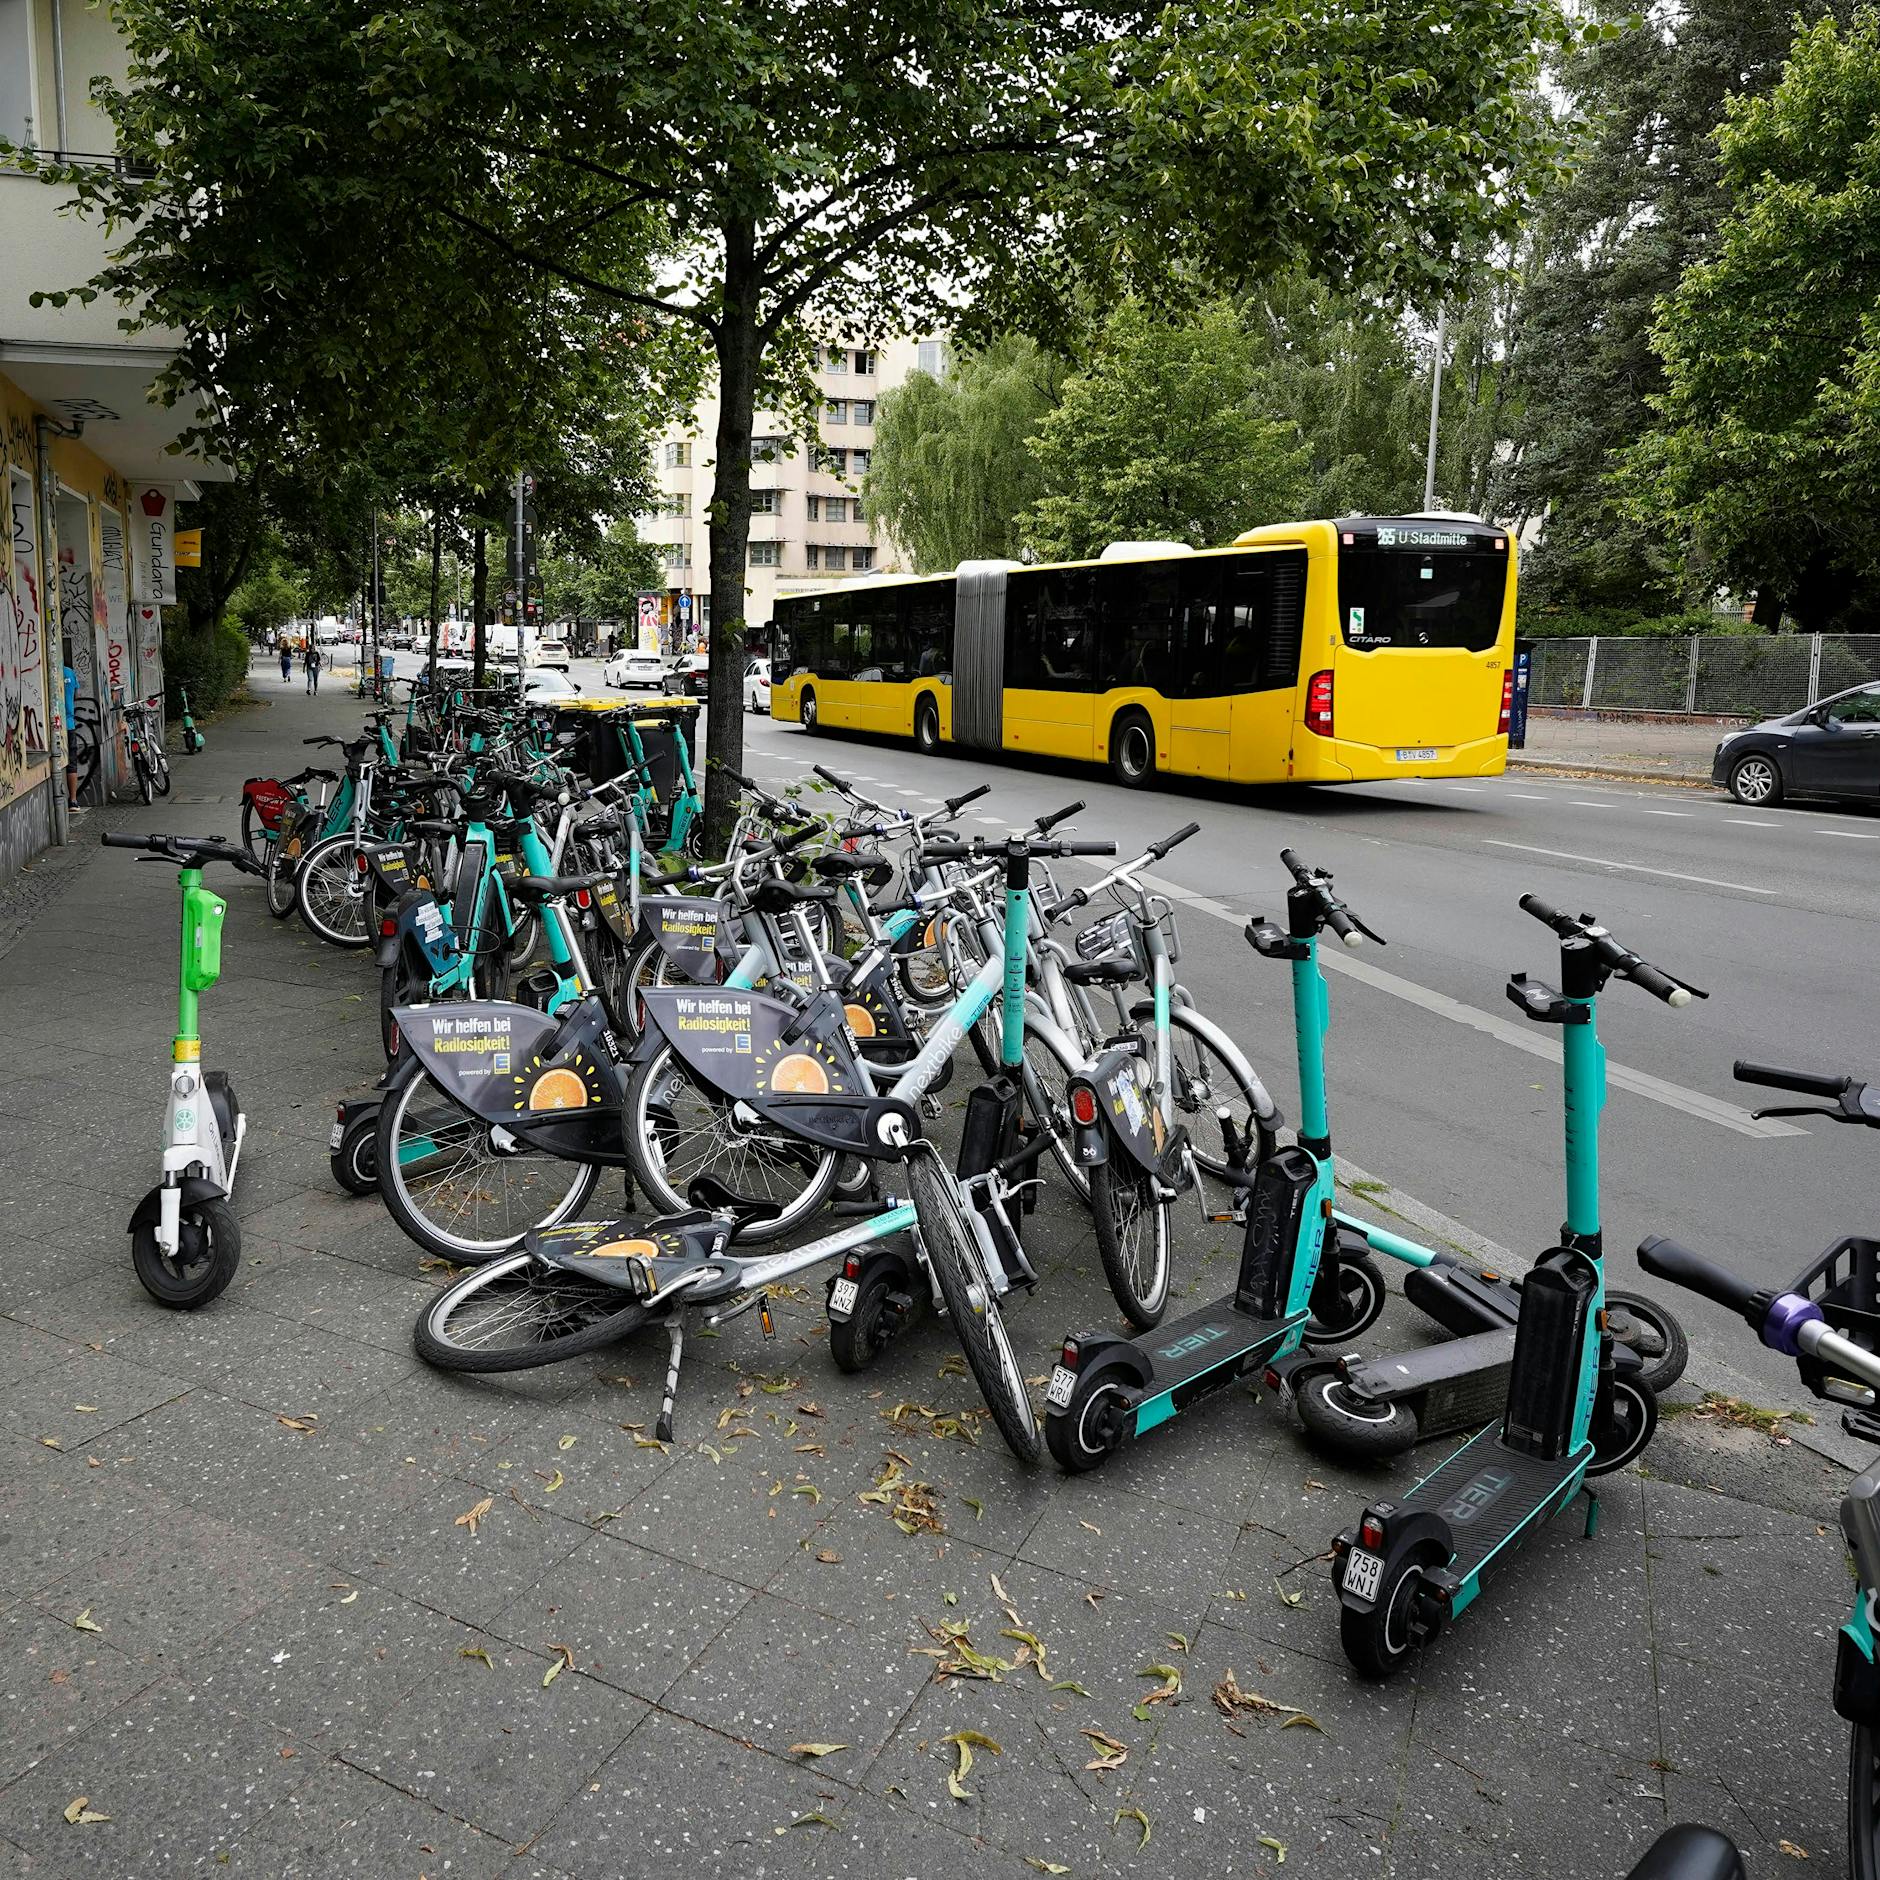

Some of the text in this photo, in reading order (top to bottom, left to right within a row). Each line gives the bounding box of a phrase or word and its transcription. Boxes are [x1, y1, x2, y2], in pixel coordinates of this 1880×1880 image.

[1398, 531, 1409, 544] U
[1410, 531, 1468, 546] Stadtmitte
[150, 522, 169, 600] Gundara
[1486, 661, 1501, 669] 4857
[1520, 653, 1527, 665] P
[661, 908, 718, 923] Wir helfen bei
[661, 921, 716, 936] Radlosigkeit!
[798, 960, 812, 972] bei
[676, 999, 751, 1015] Wir helfen bei
[432, 1017, 511, 1034] Wir helfen bei
[678, 1016, 751, 1033] Radlosigkeit!
[434, 1035, 510, 1054] Radlosigkeit!
[602, 1029, 619, 1058] 10321
[909, 1027, 963, 1100] nextbike
[971, 995, 991, 1018] TIER
[459, 1069, 483, 1077] powered
[753, 1228, 857, 1274] nextbike
[1302, 1228, 1323, 1296] TIER
[836, 1281, 856, 1297] 397
[1158, 1327, 1230, 1360] TIER
[1054, 1369, 1074, 1385] 577
[1049, 1385, 1069, 1403] WRU
[1582, 1346, 1600, 1429] TIER
[1443, 1474, 1513, 1520] TIER
[1353, 1552, 1379, 1577] 758
[1345, 1572, 1373, 1597] WNI
